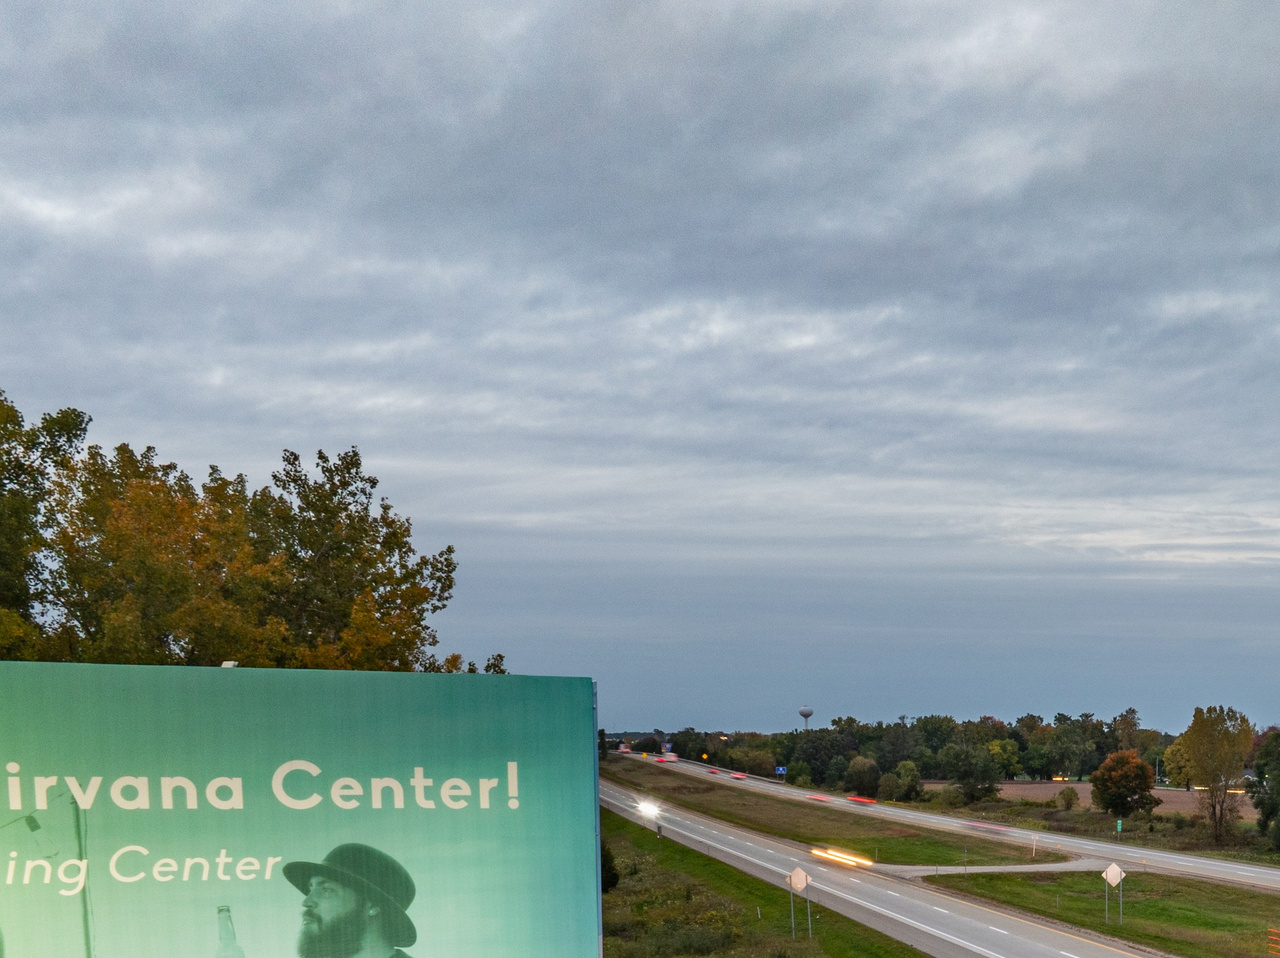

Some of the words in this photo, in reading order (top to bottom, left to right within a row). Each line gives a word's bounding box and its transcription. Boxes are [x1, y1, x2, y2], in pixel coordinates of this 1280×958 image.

[271, 760, 520, 810] Center!
[5, 851, 88, 896] ing
[109, 845, 282, 883] Center
